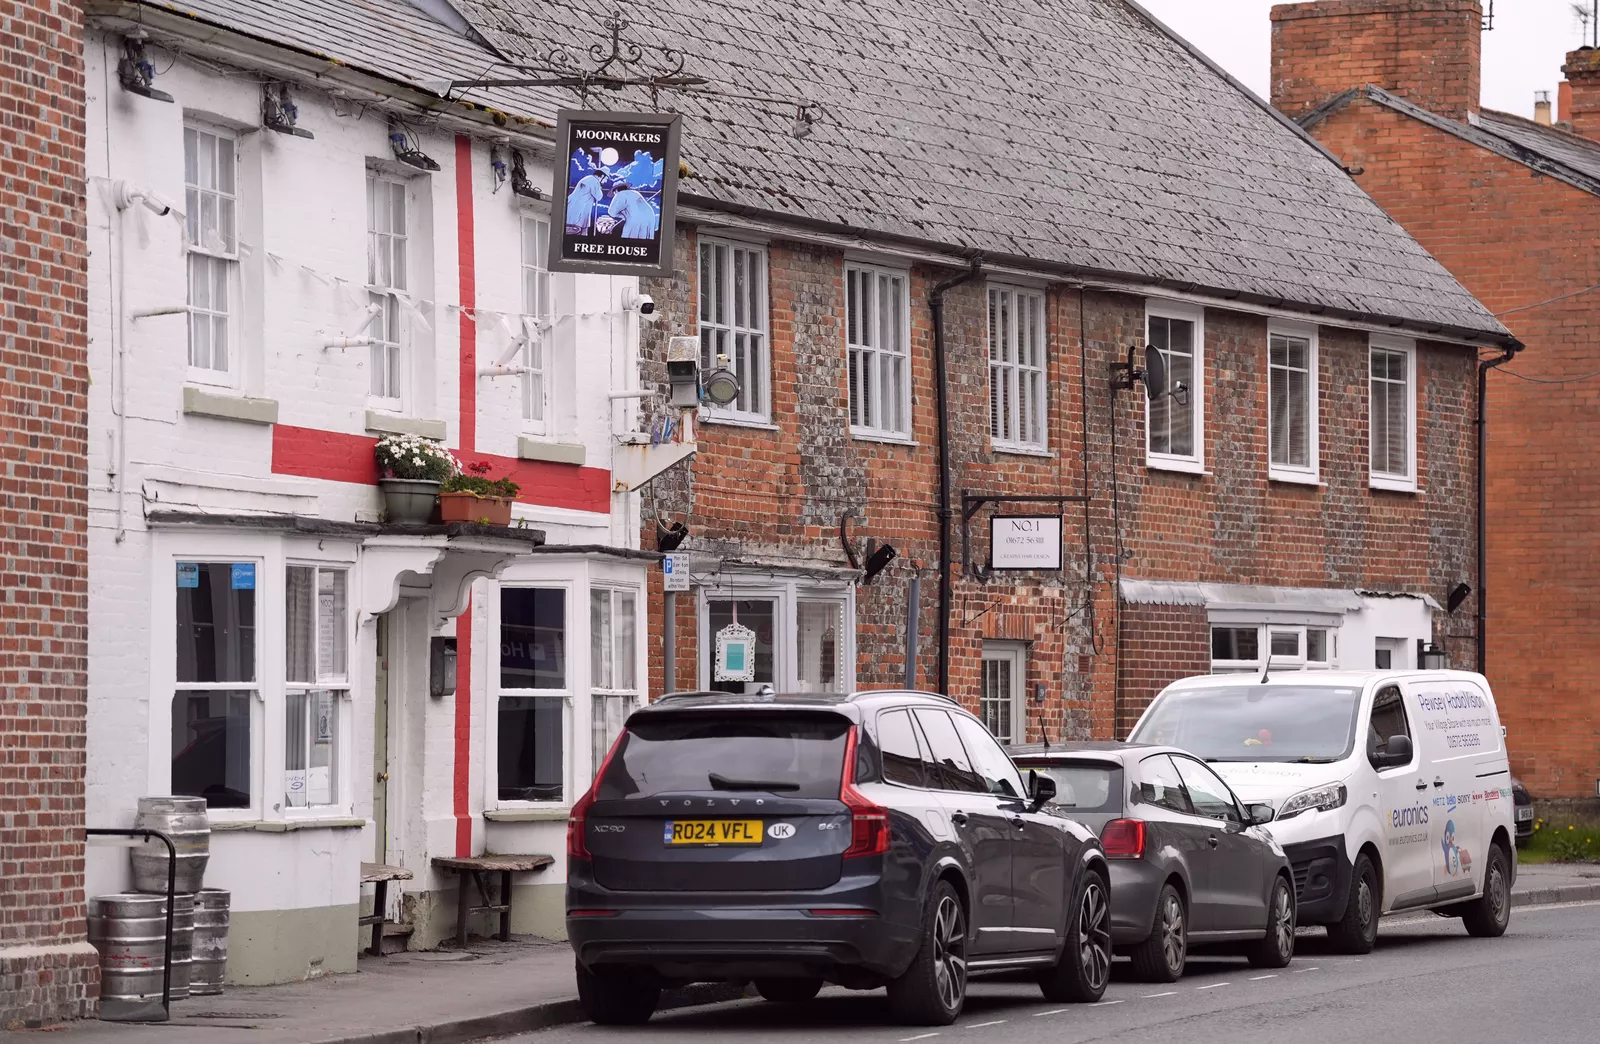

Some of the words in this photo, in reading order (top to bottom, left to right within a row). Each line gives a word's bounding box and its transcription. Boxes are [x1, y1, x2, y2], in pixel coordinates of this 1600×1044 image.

[575, 129, 661, 143] MOONRAKERS
[574, 243, 604, 254] FREE
[607, 245, 648, 256] HOUSE
[1418, 694, 1448, 715] Pewsey
[660, 799, 764, 807] VOLVO
[1457, 793, 1471, 804] SONY
[1392, 801, 1429, 828] euronics
[593, 825, 625, 833] XC90
[672, 822, 716, 840] RO24
[722, 822, 753, 839] VFL
[773, 825, 789, 837] UK
